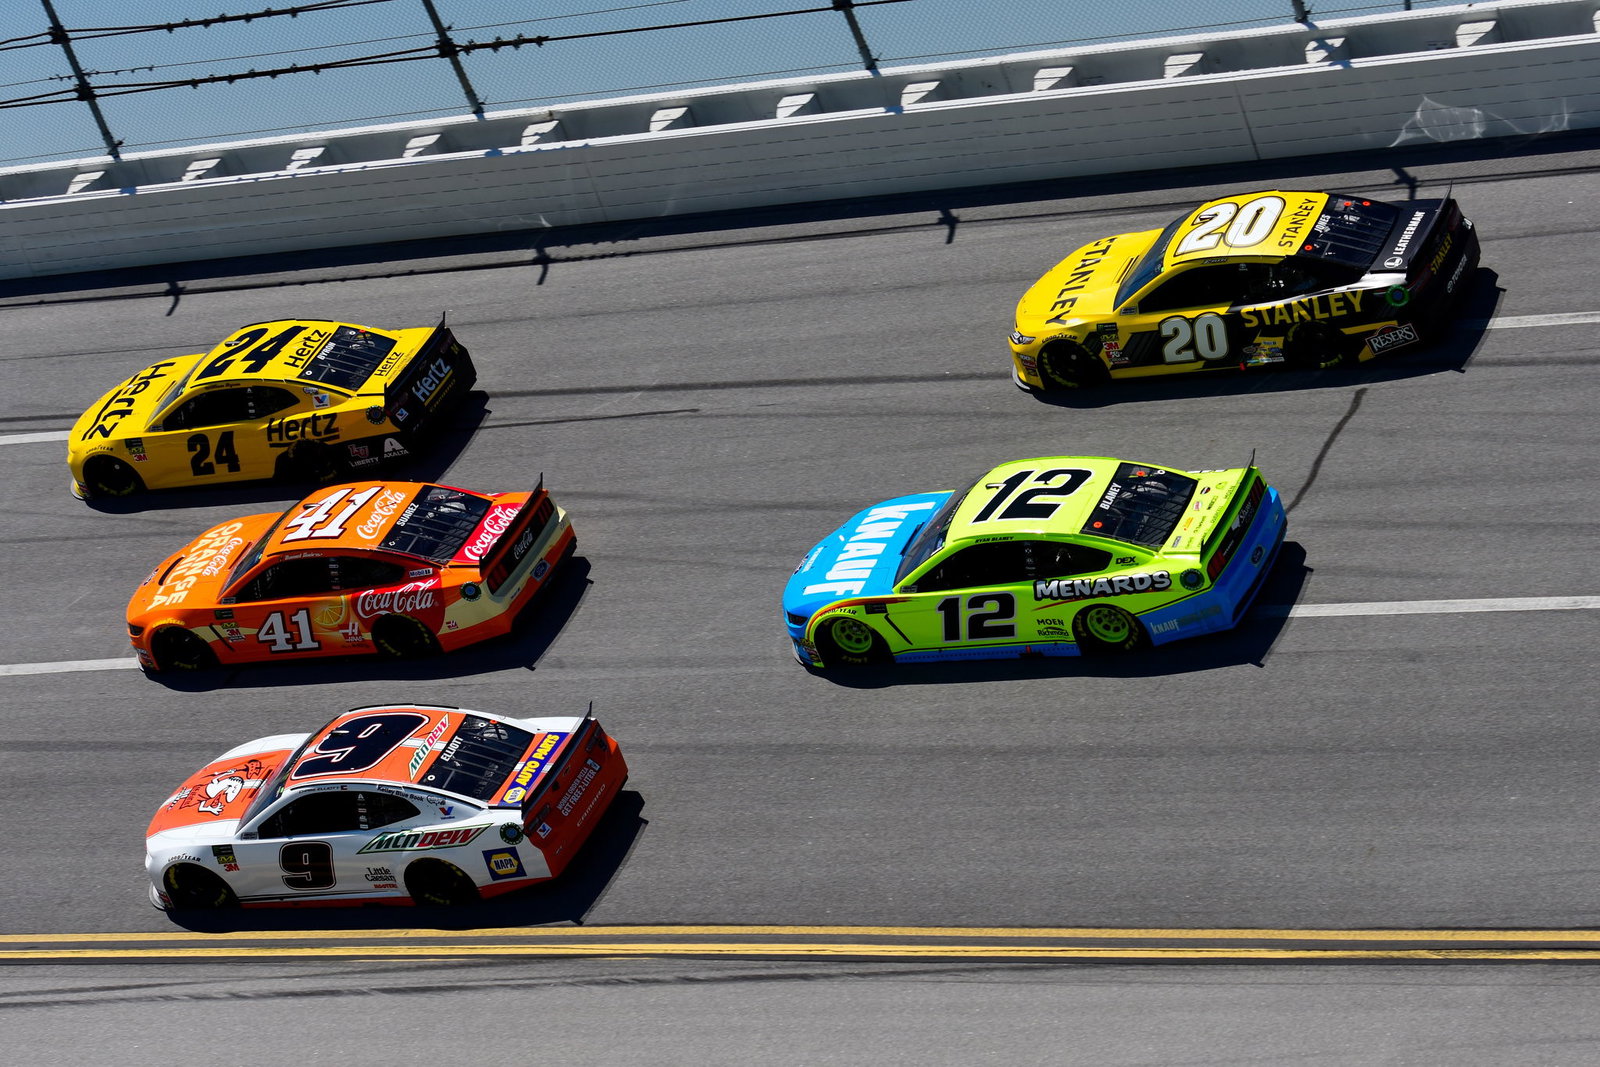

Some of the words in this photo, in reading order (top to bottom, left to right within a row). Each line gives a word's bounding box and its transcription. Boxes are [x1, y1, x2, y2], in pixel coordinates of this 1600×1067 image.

[1174, 196, 1286, 257] 20
[1278, 198, 1318, 248] STANLEY
[1314, 214, 1331, 233] JONES
[1393, 211, 1425, 255] LEATHERMAN
[1431, 233, 1453, 274] STANLEY
[1046, 237, 1117, 325] STANLEY
[1240, 289, 1363, 328] STANLEY
[194, 327, 310, 382] 24
[284, 329, 326, 368] Hertz
[317, 342, 336, 361] BYRON
[1103, 342, 1120, 351] 3M
[1159, 311, 1231, 364] 20
[374, 351, 401, 377] Hertz
[411, 357, 450, 402] Hertz
[86, 361, 176, 440] Hertz
[267, 412, 339, 442] Hertz
[132, 453, 148, 463] 3M
[187, 431, 241, 477] 24
[349, 456, 379, 467] LIBERTY
[383, 449, 409, 458] AXALTA
[280, 486, 384, 544] 41
[396, 503, 419, 527] SUAREZ
[969, 468, 1094, 525] 12
[1100, 482, 1122, 510] BLANEY
[146, 525, 227, 611] VANILLA
[164, 522, 243, 606] ORANGE
[803, 502, 936, 595] KNAUF
[1115, 556, 1136, 564] DEX
[409, 569, 425, 577] Mobil
[1034, 571, 1172, 601] MENARDS
[226, 628, 240, 638] 3M
[257, 609, 320, 653] 41
[936, 592, 1017, 643] 12
[1037, 618, 1065, 626] MOEN
[1150, 619, 1180, 635] KNAUF
[291, 712, 430, 780] 9
[440, 735, 464, 762] ELLIOTT
[505, 788, 521, 803] NAPA
[515, 760, 540, 786] AUTO
[534, 734, 560, 761] PARTS
[377, 784, 396, 796] Kelley
[396, 790, 409, 799] Blue
[409, 793, 424, 802] Book
[561, 802, 574, 817] GET
[568, 788, 583, 805] FREE
[577, 768, 597, 792] 2-LITER
[223, 863, 239, 872] 3M
[279, 842, 336, 890] 9
[366, 866, 391, 876] Little
[493, 858, 516, 871] NAPA
